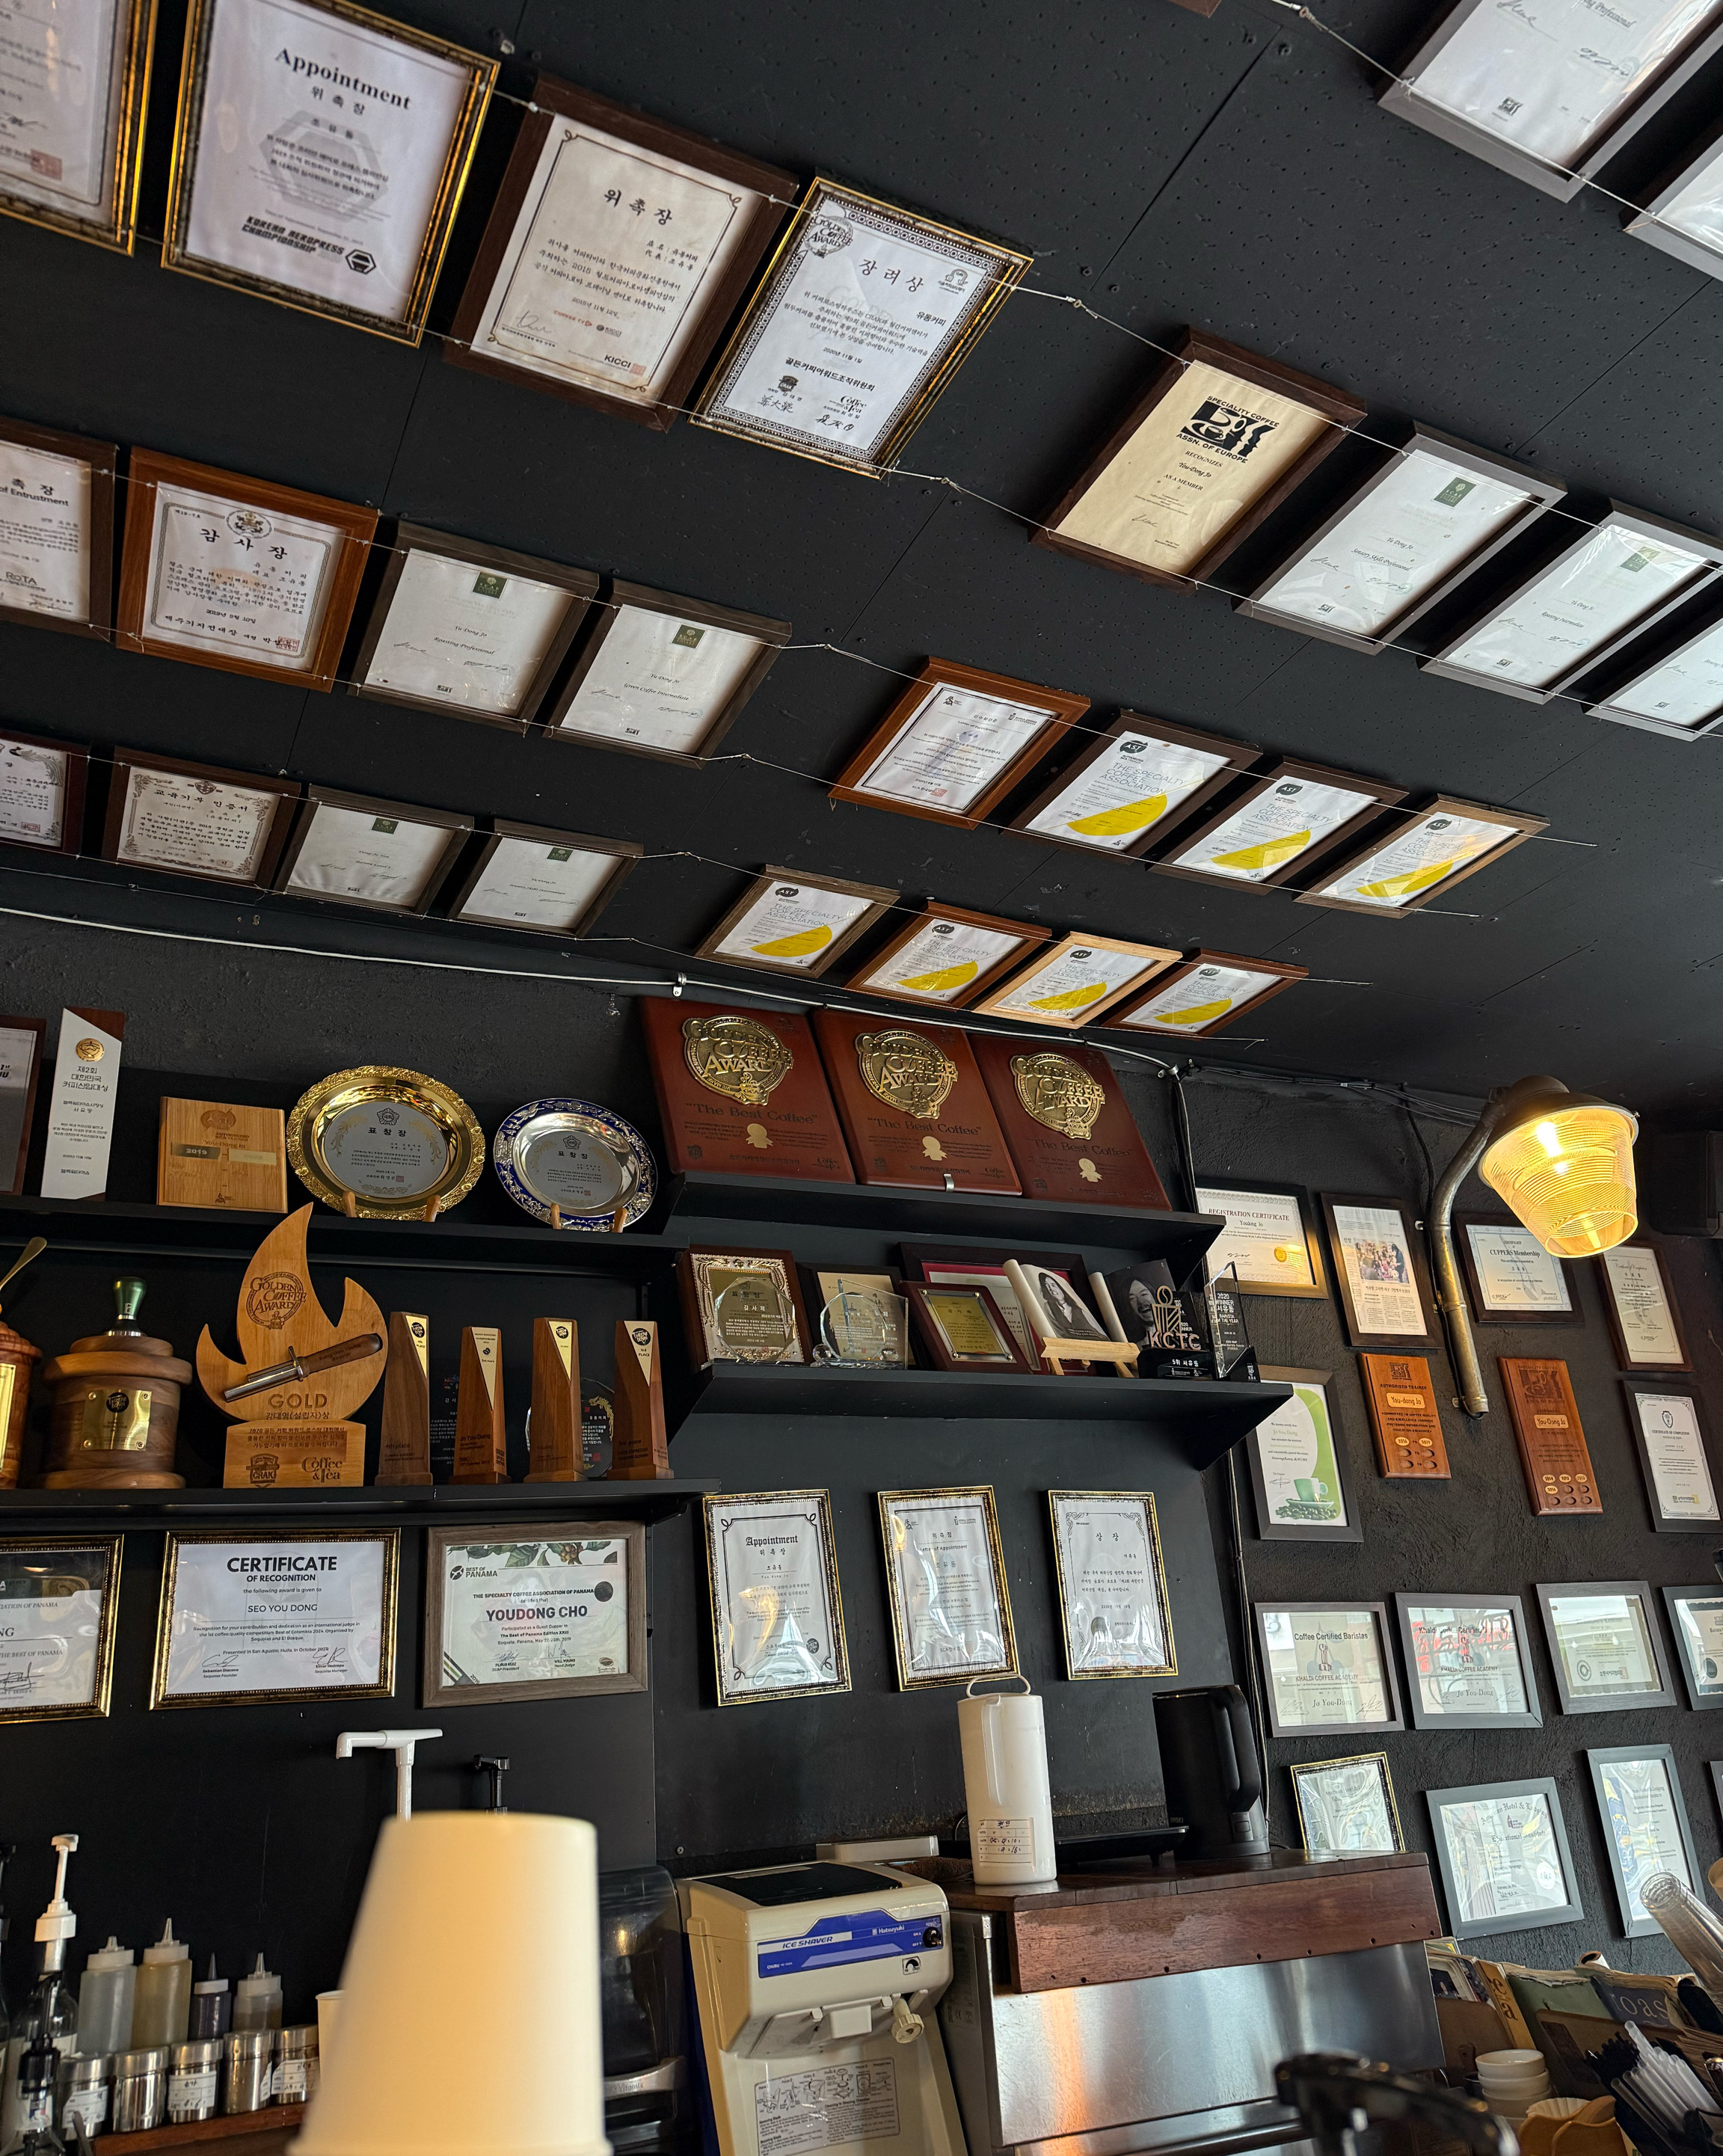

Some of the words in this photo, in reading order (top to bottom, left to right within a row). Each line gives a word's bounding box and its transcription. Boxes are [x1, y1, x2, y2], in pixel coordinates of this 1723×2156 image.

[275, 47, 411, 110] Appointment
[810, 232, 841, 248] AWARD
[859, 258, 924, 292] 장려상
[916, 311, 947, 327] 유동커피
[604, 354, 632, 369] KICCI
[785, 357, 876, 392] 골든커피어워드조직위원회
[1206, 395, 1251, 416] SPECIALITY
[1250, 412, 1280, 428] COFFEE
[1176, 433, 1200, 446] ASSN.
[1203, 443, 1214, 452] OF
[1214, 446, 1248, 464] EUROPE
[1185, 450, 1223, 468] RECOGNIZES
[1177, 478, 1204, 491] MEMBER
[10, 488, 70, 507] Entrustment
[200, 529, 288, 559] 감사장
[460, 643, 496, 655] Professional
[1125, 743, 1143, 751] AST
[1106, 769, 1147, 783] COFFEE
[1112, 762, 1132, 773] THE
[1132, 767, 1187, 786] SPECIALTY
[1099, 774, 1167, 794] ASSOCIATION
[1259, 808, 1296, 821] COFFEE
[1266, 803, 1285, 812] THE
[1285, 808, 1333, 823] SPECIALTY
[1252, 814, 1313, 832] ASSOCIATION
[770, 907, 808, 919] COFFEE
[774, 903, 793, 911] THE
[793, 907, 843, 920] SPECIALTY
[765, 912, 829, 927] ASSOCIATION
[919, 947, 977, 962] ASSOCIATION
[923, 943, 958, 955] COFFEE
[946, 944, 992, 956] SPECIALTY
[1054, 971, 1107, 984] ASSOCIATION
[1059, 968, 1090, 977] COFFEE
[1078, 965, 1122, 978] SPECIALTY
[713, 1040, 795, 1069] COFFEE
[77, 1066, 98, 1074] 제2회
[703, 1055, 773, 1077] AWARD
[886, 1054, 959, 1082] COFFEE
[70, 1073, 102, 1083] 대한민국
[879, 1067, 942, 1092] AWARD
[62, 1081, 108, 1092] 커피산업대상
[1037, 1077, 1106, 1105] COFFEE
[1031, 1086, 1091, 1114] AWARD
[730, 1106, 762, 1120] Best
[368, 1127, 407, 1137] 표창장
[904, 1120, 933, 1133] Best
[204, 1140, 237, 1149] You-Dong
[1061, 1140, 1089, 1153] Best
[557, 1150, 589, 1161] 표창장
[1208, 1208, 1251, 1217] REGISTRATION
[1252, 1212, 1290, 1221] CERTIFICATE
[1490, 1248, 1514, 1256] CUPPERS
[1514, 1250, 1541, 1258] Membership
[250, 1277, 297, 1292] GOLDEN
[262, 1289, 307, 1303] COFFEE
[254, 1298, 295, 1314] AWARD
[1150, 1331, 1202, 1351] KCTC
[268, 1393, 328, 1409] GOLD
[1391, 1396, 1415, 1406] You-dong
[1537, 1417, 1560, 1427] You-Dong
[301, 1456, 343, 1473] Coffee
[252, 1470, 275, 1479] CRAK
[313, 1468, 341, 1483] &Tea
[746, 1535, 799, 1547] Appointment
[1096, 1532, 1119, 1541] 상장
[227, 1556, 338, 1573] CERTIFICATE
[246, 1574, 259, 1582] OF
[259, 1574, 316, 1582] RECOGNITION
[465, 1570, 498, 1578] PANAMA
[253, 1587, 277, 1595] following
[301, 1587, 316, 1595] given
[248, 1605, 267, 1614] SEO
[268, 1604, 289, 1613] YOU
[289, 1603, 318, 1613] DONG
[486, 1607, 556, 1621] YOUDONG
[559, 1605, 588, 1618] CHO
[1294, 1633, 1315, 1641] Coffee
[1315, 1632, 1342, 1641] Certified
[1343, 1632, 1369, 1640] Baristas
[470, 1673, 480, 1685] 2019
[1312, 1698, 1320, 1708] Jo
[1502, 1802, 1518, 1812] Hotel
[878, 1925, 905, 1935] Hatsuyuki
[782, 1941, 798, 1949] ICE
[798, 1936, 833, 1947] SHAVER
